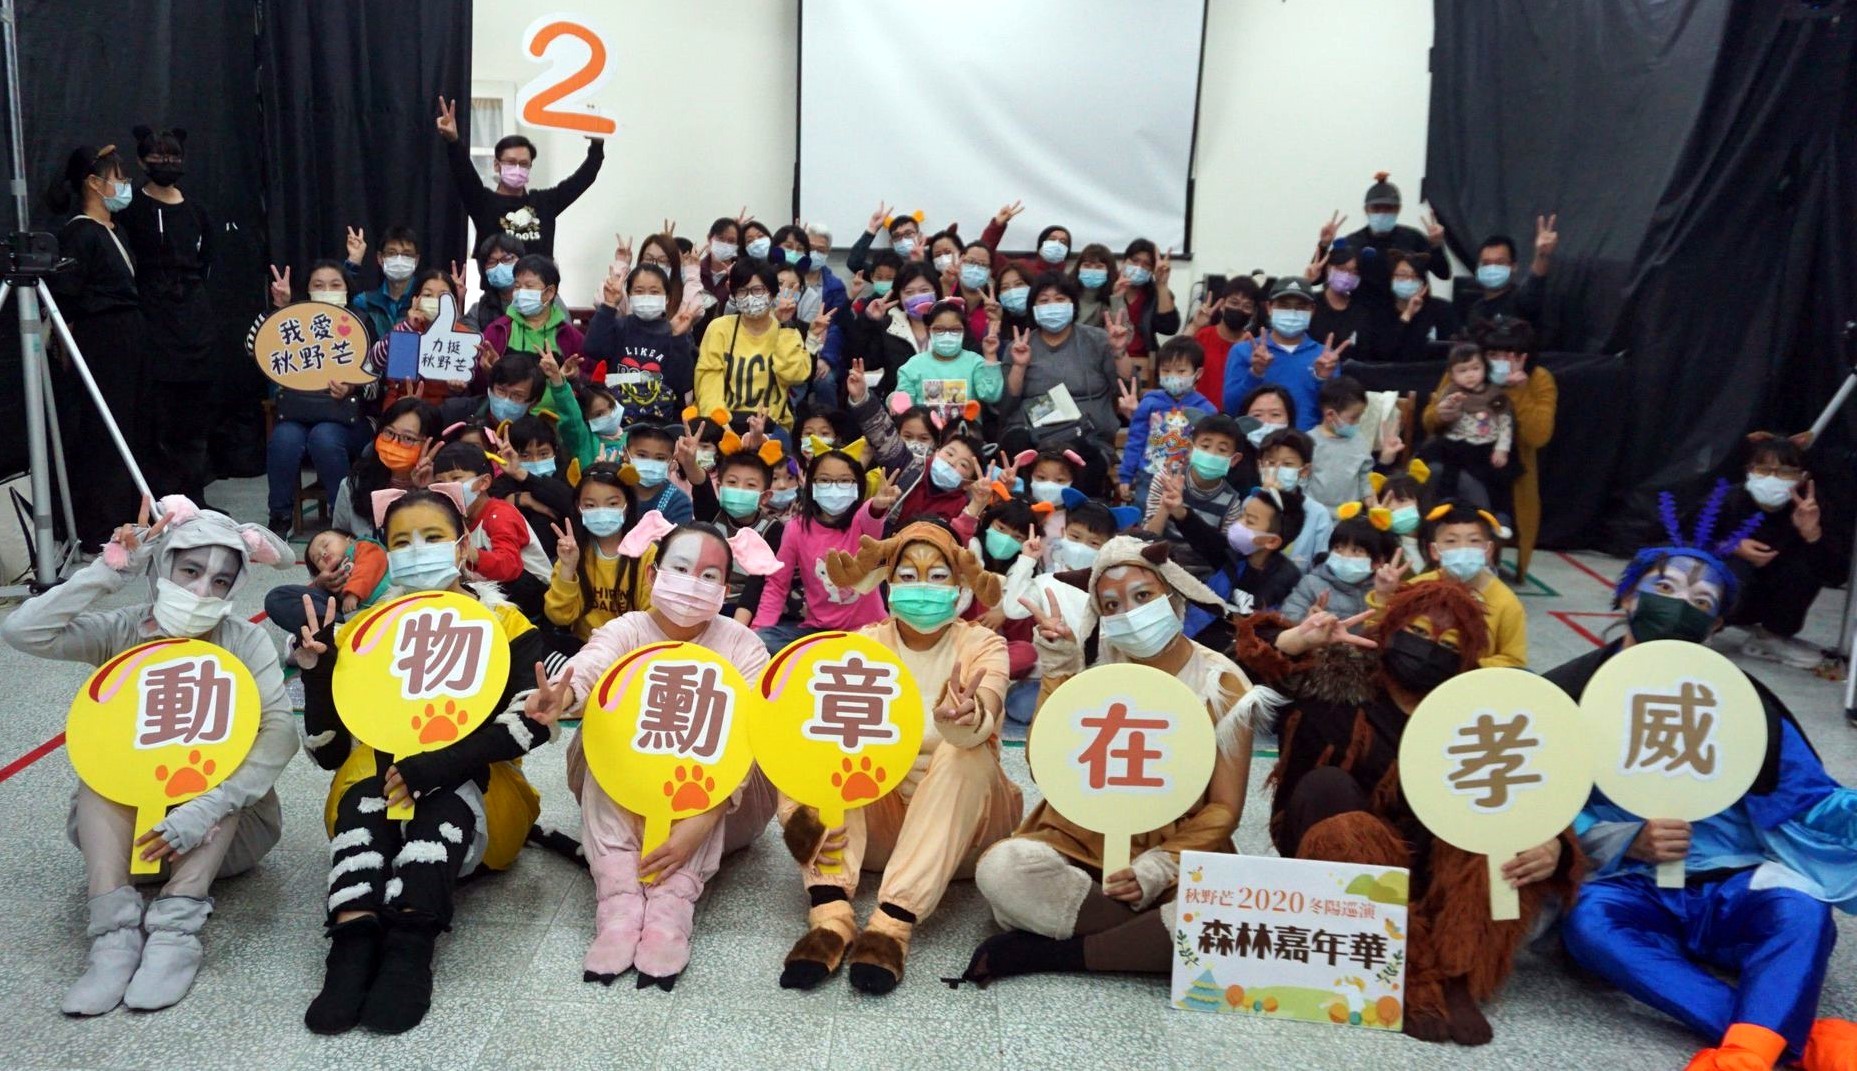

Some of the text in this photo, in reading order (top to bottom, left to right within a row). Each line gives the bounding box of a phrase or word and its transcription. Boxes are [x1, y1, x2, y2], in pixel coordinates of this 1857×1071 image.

[523, 21, 617, 134] 2
[271, 341, 354, 375] 秋野芒
[280, 313, 334, 345] 我愛
[421, 353, 467, 373] 秋野芒
[432, 338, 461, 354] 力挺
[398, 612, 484, 695] 物
[140, 660, 232, 746] 動
[637, 664, 728, 757] 勳
[809, 657, 894, 749] 章
[1078, 703, 1169, 789] 在
[1624, 682, 1717, 775] 威
[1448, 714, 1542, 808] 孝
[1198, 919, 1389, 971] 森林嘉年華
